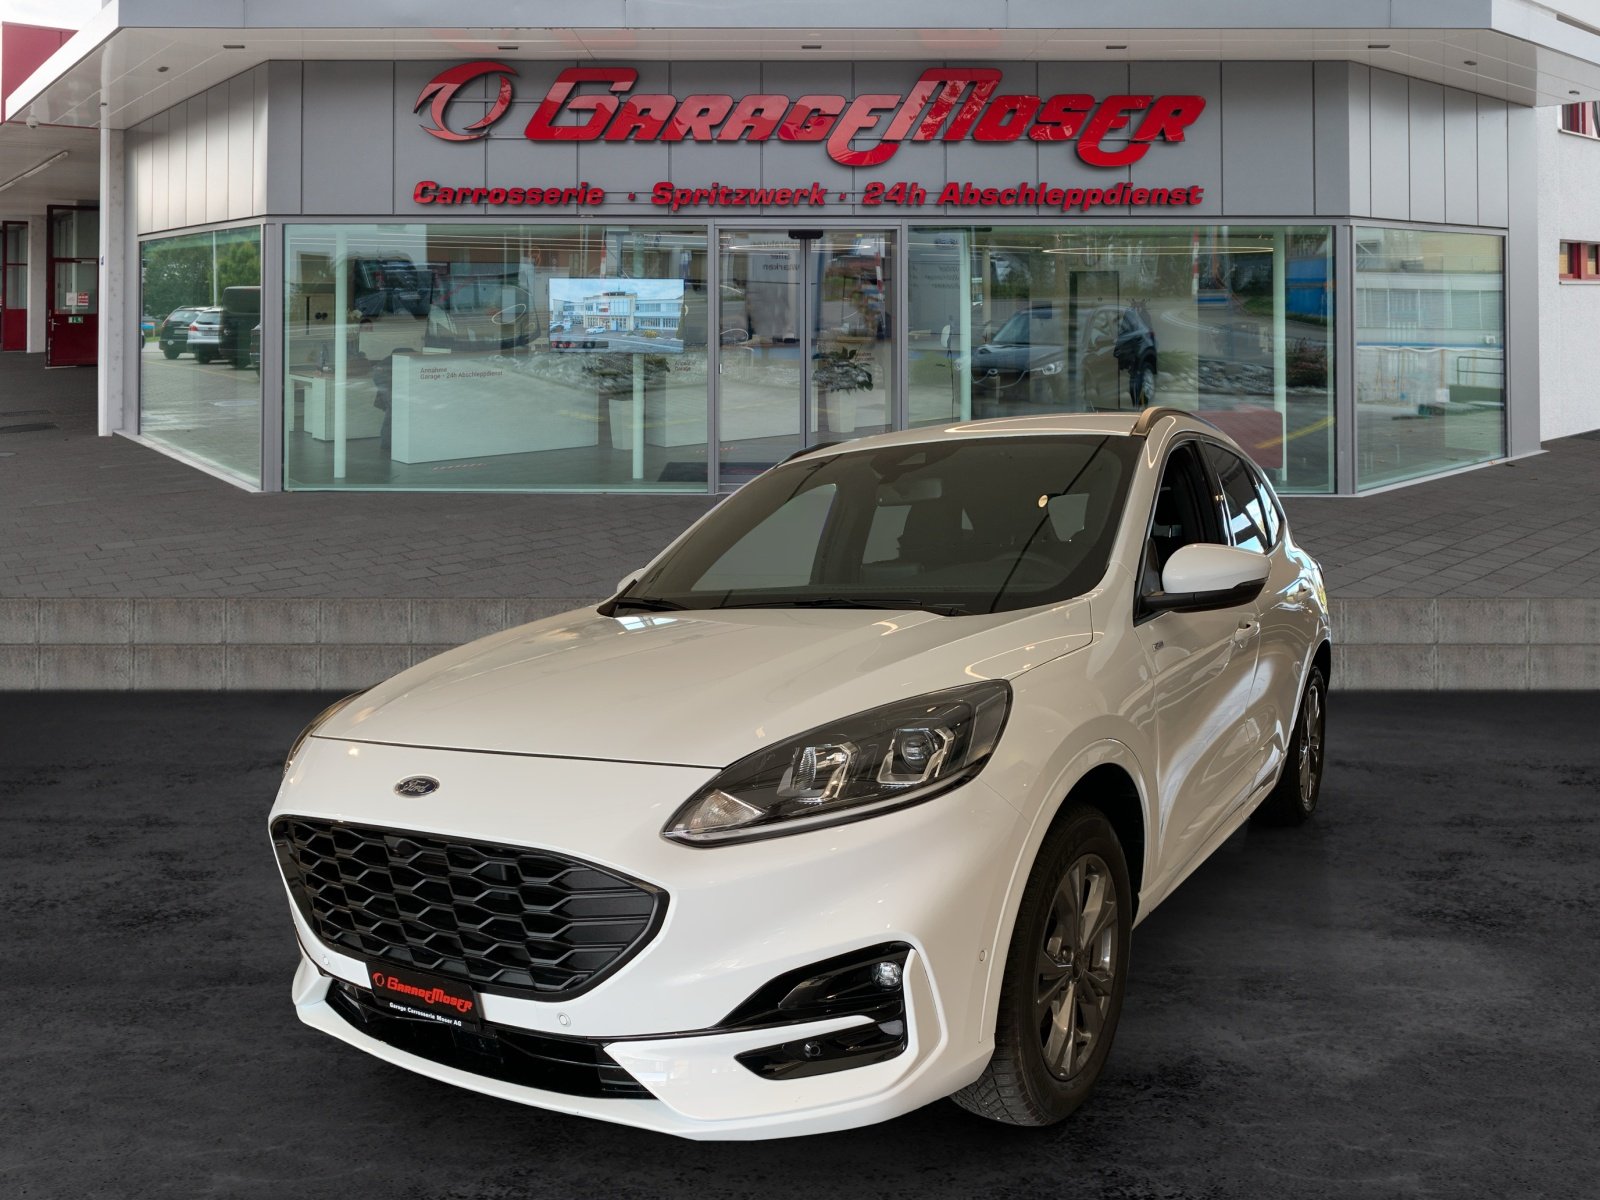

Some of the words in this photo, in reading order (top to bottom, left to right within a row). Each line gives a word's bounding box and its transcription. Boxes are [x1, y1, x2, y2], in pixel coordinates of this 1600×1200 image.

[412, 180, 605, 206] Carrosserie
[650, 181, 827, 212] Spritzwerk
[862, 181, 927, 206] 24h
[936, 181, 1205, 212] Abschleppdienst
[458, 370, 503, 378] Abschleppdienst
[389, 1002, 407, 1012] Garage
[407, 1007, 436, 1020] Carrosserie
[436, 1014, 453, 1025] Moser
